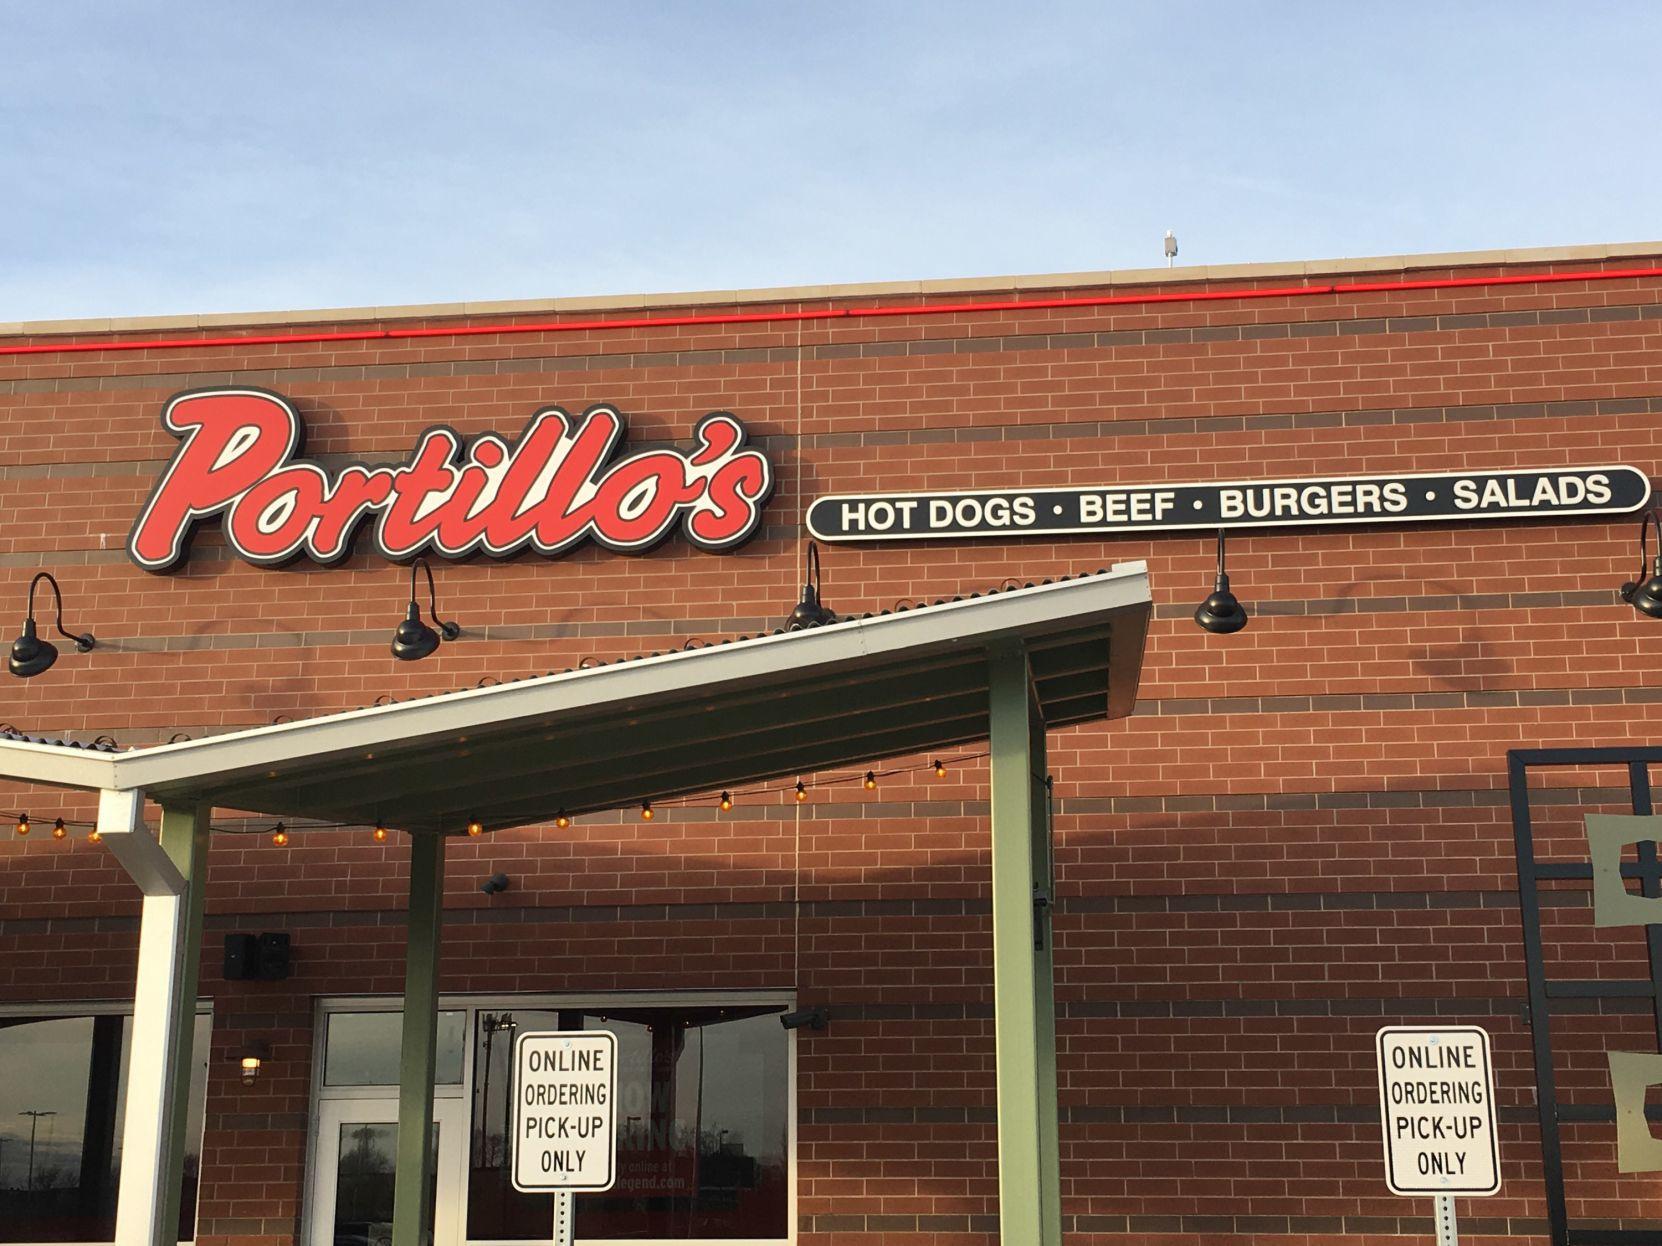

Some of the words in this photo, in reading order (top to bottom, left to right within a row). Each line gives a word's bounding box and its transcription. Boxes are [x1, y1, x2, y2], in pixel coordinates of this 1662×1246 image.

[130, 387, 768, 566] Portillo's
[841, 501, 918, 531] HOT
[929, 496, 1036, 528] DOGS
[1079, 492, 1176, 523] BEEF
[1219, 484, 1407, 519] BURGERS
[1453, 474, 1612, 509] SALADS
[529, 1049, 604, 1072] ONLINE
[1392, 1046, 1476, 1069] ONLINE
[525, 1083, 607, 1106] ORDERING
[1391, 1081, 1483, 1105] ORDERING
[525, 1116, 603, 1139] PICK-UP
[1396, 1116, 1482, 1140] PICK-UP
[540, 1150, 586, 1173] ONLY
[1417, 1152, 1466, 1176] ONLY
